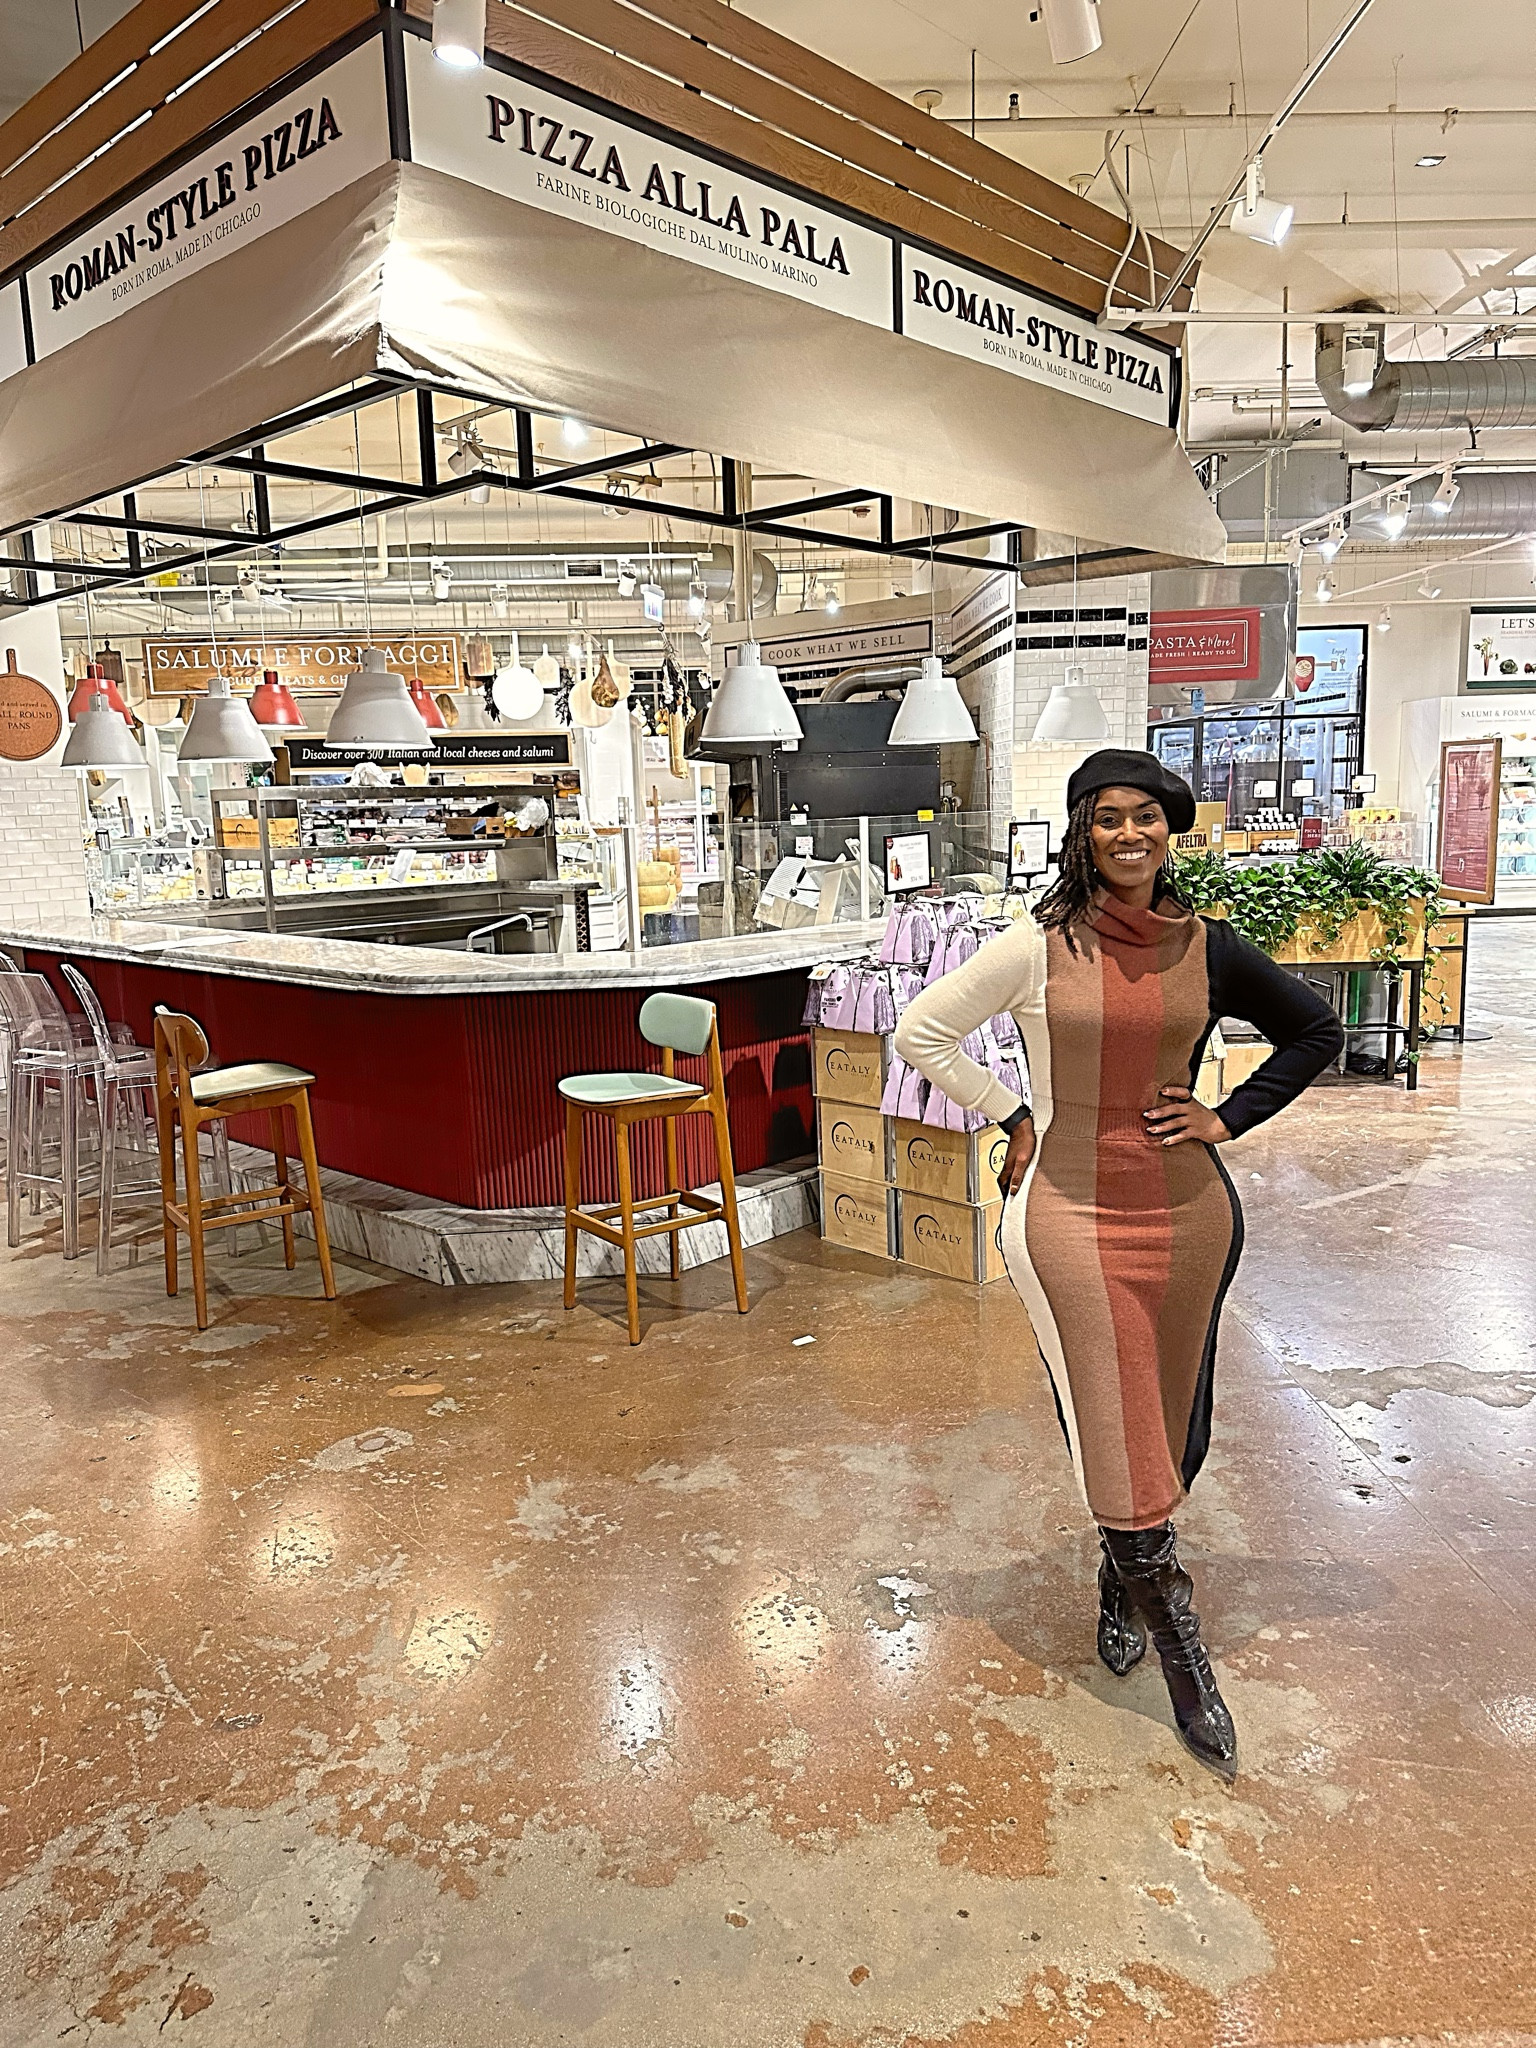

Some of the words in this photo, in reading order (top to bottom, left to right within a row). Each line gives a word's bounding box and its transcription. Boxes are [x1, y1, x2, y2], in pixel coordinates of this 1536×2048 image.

[485, 94, 631, 192] PIZZA
[640, 163, 751, 238] ALLA
[760, 207, 850, 275] PALA
[49, 161, 236, 311] ROMAN-STYLE
[242, 97, 342, 191] PIZZA
[536, 171, 591, 205] FARINE
[595, 194, 686, 241] BIOLOGICHE
[690, 229, 715, 251] DAL
[718, 240, 768, 269] MULINO
[772, 259, 818, 288] MARINO
[112, 277, 134, 301] BORN
[134, 268, 145, 289] IN
[146, 256, 174, 283] ROMA,
[175, 239, 201, 265] MADE
[202, 230, 213, 250] IN
[215, 202, 261, 241] CHICAGO
[912, 269, 1099, 370] ROMAN-STYLE
[1105, 346, 1164, 394] PIZZA
[983, 338, 1007, 357] BORN
[1008, 348, 1018, 360] IN
[1019, 352, 1045, 371] ROMA,
[1046, 361, 1068, 378] MADE
[1069, 369, 1078, 381] IN
[1079, 373, 1112, 394] CHICAGO
[1501, 618, 1535, 629] LET'S
[768, 647, 801, 660] COOK
[807, 642, 843, 656] WHAT
[848, 639, 867, 650] WE
[873, 634, 905, 648] SELL
[1148, 636, 1197, 650] PASTA
[1207, 632, 1236, 649] More!
[156, 648, 264, 669] SALUMI
[273, 647, 289, 667] E
[229, 676, 260, 686] CURE
[318, 675, 327, 684] &
[19, 711, 52, 719] ROUND
[1460, 710, 1493, 718] SALUMI
[302, 748, 342, 760] Discover
[344, 750, 365, 759] over
[366, 749, 384, 760] 300
[387, 749, 420, 759] Italian
[422, 746, 441, 758] and
[443, 746, 466, 758] local
[467, 746, 500, 758] cheeses
[502, 745, 521, 757] and
[522, 745, 554, 757] salumi
[1176, 833, 1207, 849] AFELTRA
[830, 1061, 871, 1075] EATALY
[835, 1134, 874, 1148] EATALY
[911, 1149, 955, 1167] EATALY
[838, 1206, 877, 1223] EATALY
[918, 1226, 962, 1245] EATALY
